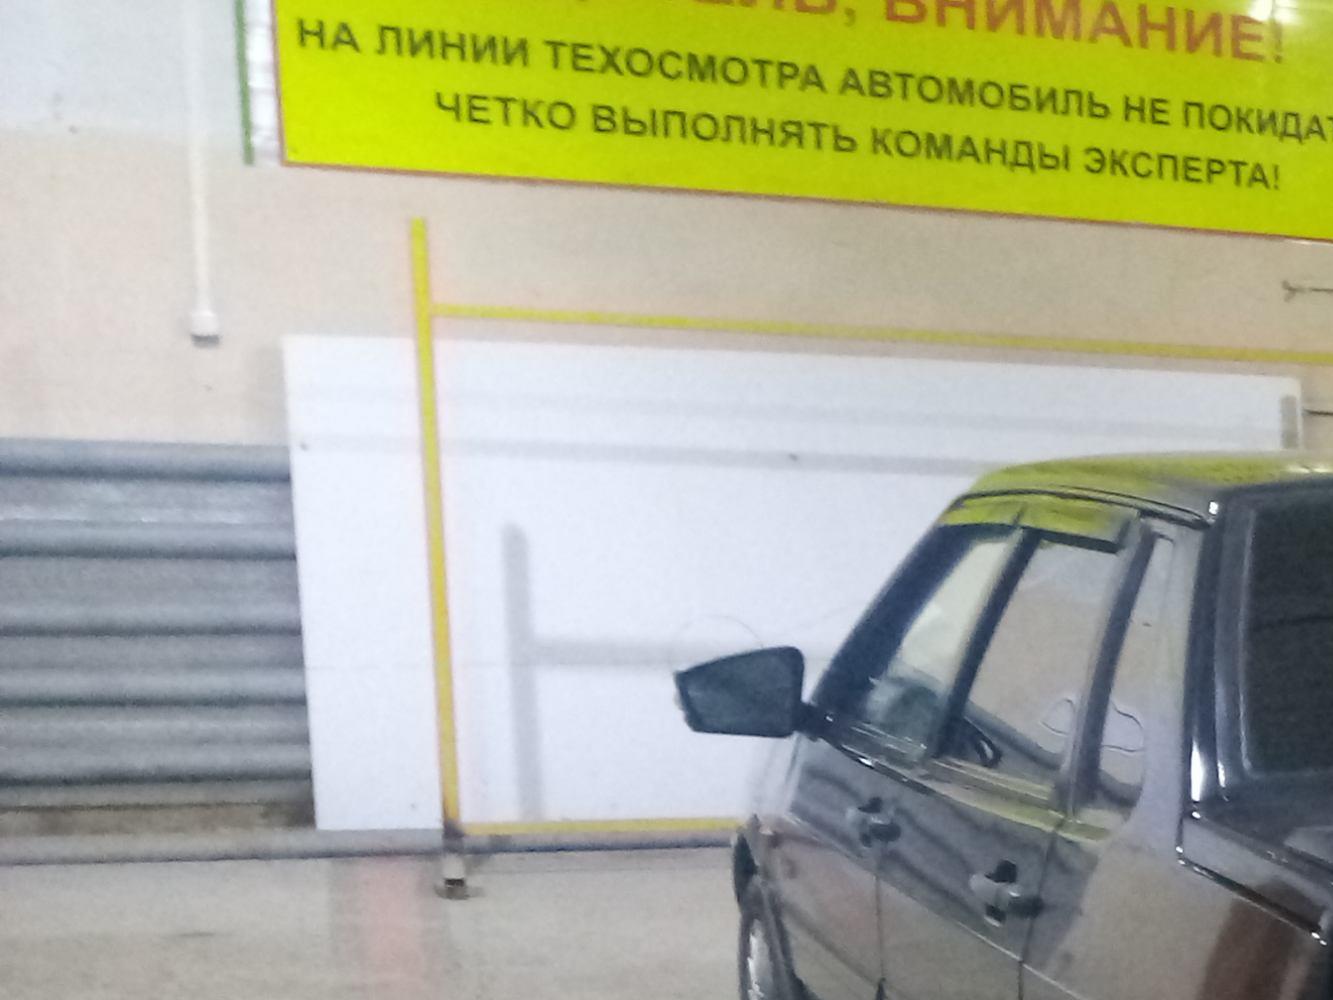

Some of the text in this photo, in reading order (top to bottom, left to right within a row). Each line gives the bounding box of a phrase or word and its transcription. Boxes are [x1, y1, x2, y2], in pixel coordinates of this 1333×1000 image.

[297, 19, 360, 53] НА
[376, 25, 529, 68] ЛИНИИ
[545, 40, 825, 94] ТЕХОСМОТРА
[839, 66, 1110, 121] АВТОМОБИЛЬ
[1123, 95, 1171, 127] НЕ
[436, 92, 1280, 191] ЧЕТКО ВЫПОЛНЯТЬ КОМАНДЫ ЭКСПЕРТА!
